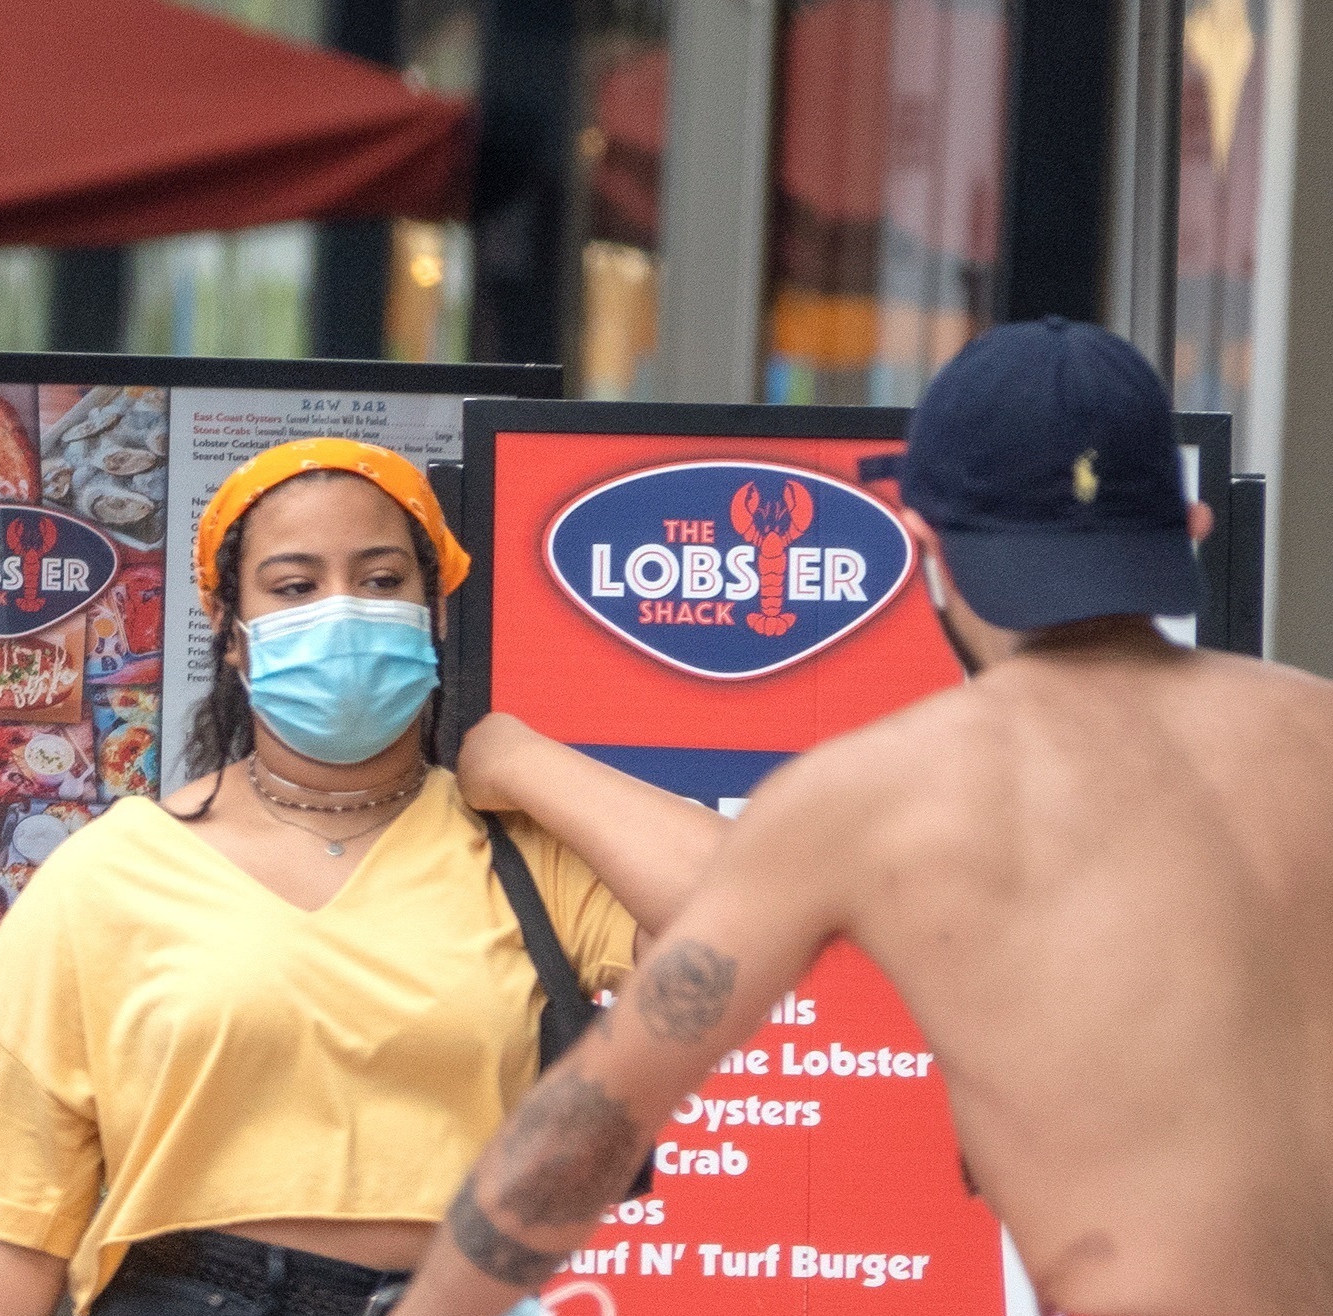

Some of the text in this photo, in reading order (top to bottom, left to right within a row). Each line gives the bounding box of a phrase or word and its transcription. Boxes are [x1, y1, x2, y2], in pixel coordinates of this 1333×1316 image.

[193, 439, 229, 448] Lobster
[231, 440, 270, 449] Cocktail
[193, 452, 225, 461] Seared
[663, 519, 716, 544] THE
[638, 600, 736, 626] SHACK
[783, 1043, 933, 1077] Lobster
[673, 1093, 821, 1132] Oysters
[655, 1141, 748, 1175] Crab
[555, 1241, 931, 1287] urf N' Turf Burger
